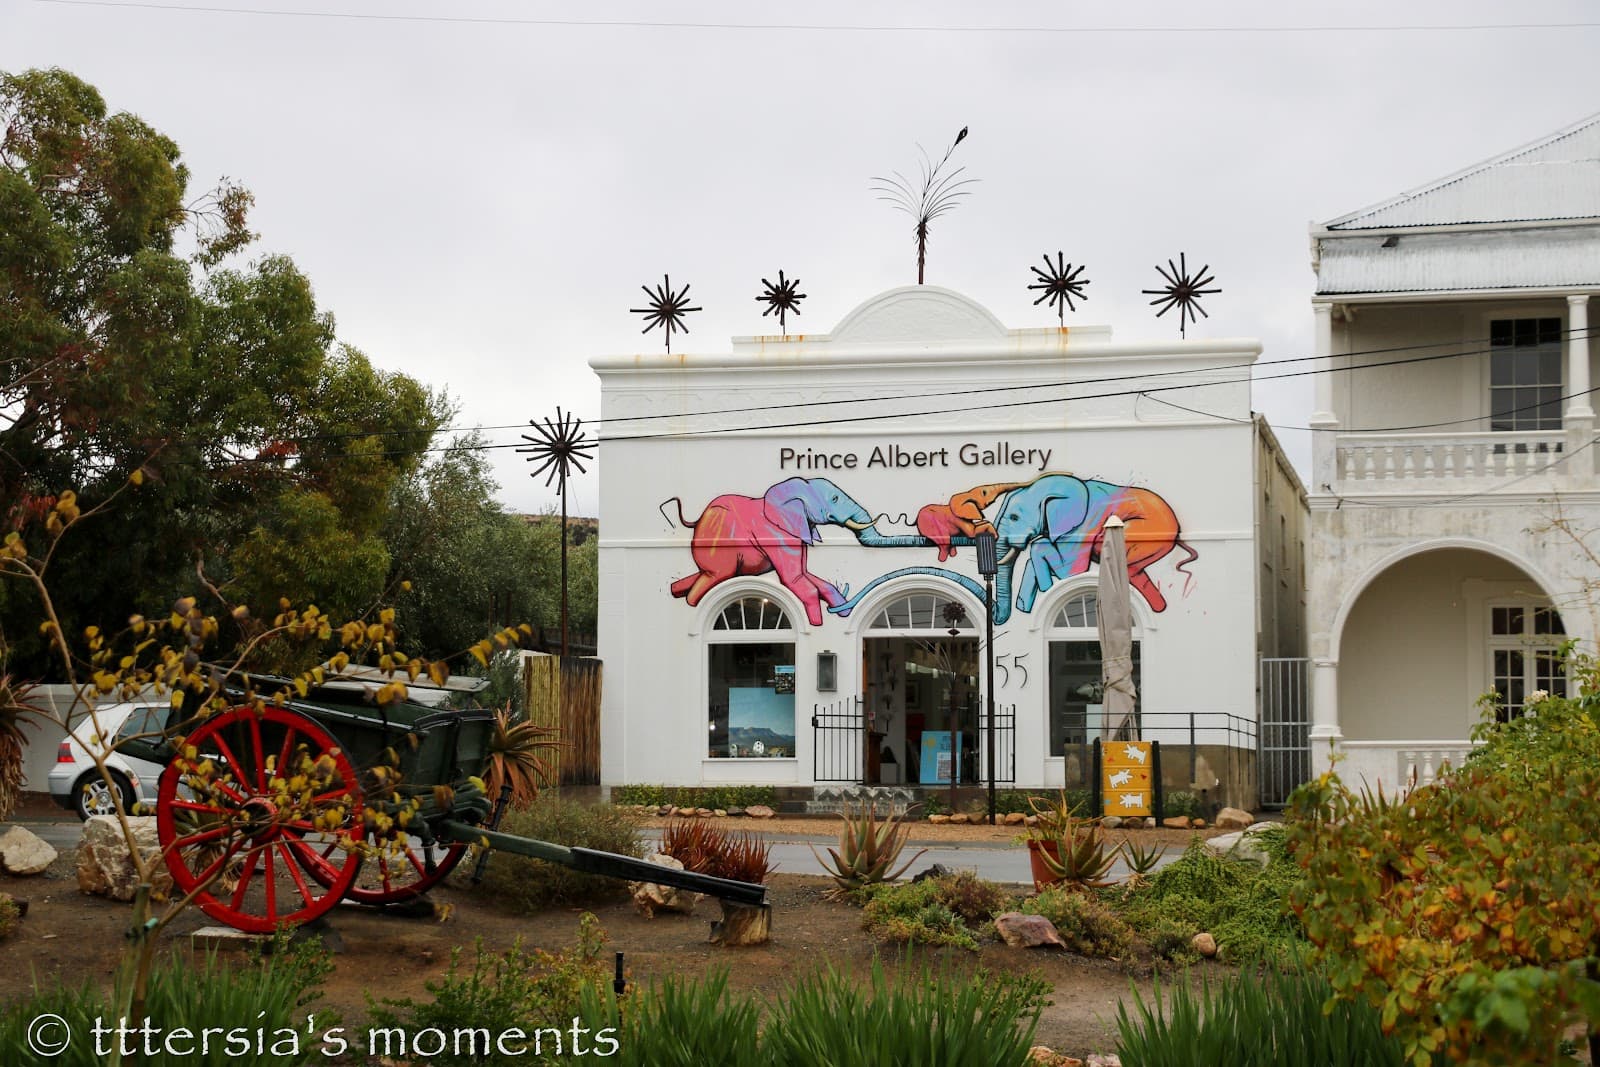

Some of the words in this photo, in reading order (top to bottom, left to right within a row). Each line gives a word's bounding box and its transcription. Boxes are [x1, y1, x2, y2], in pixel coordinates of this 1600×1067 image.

[780, 447, 858, 469] Prince
[867, 445, 949, 468] Albert
[959, 442, 1052, 471] Gallery
[996, 653, 1029, 689] 55
